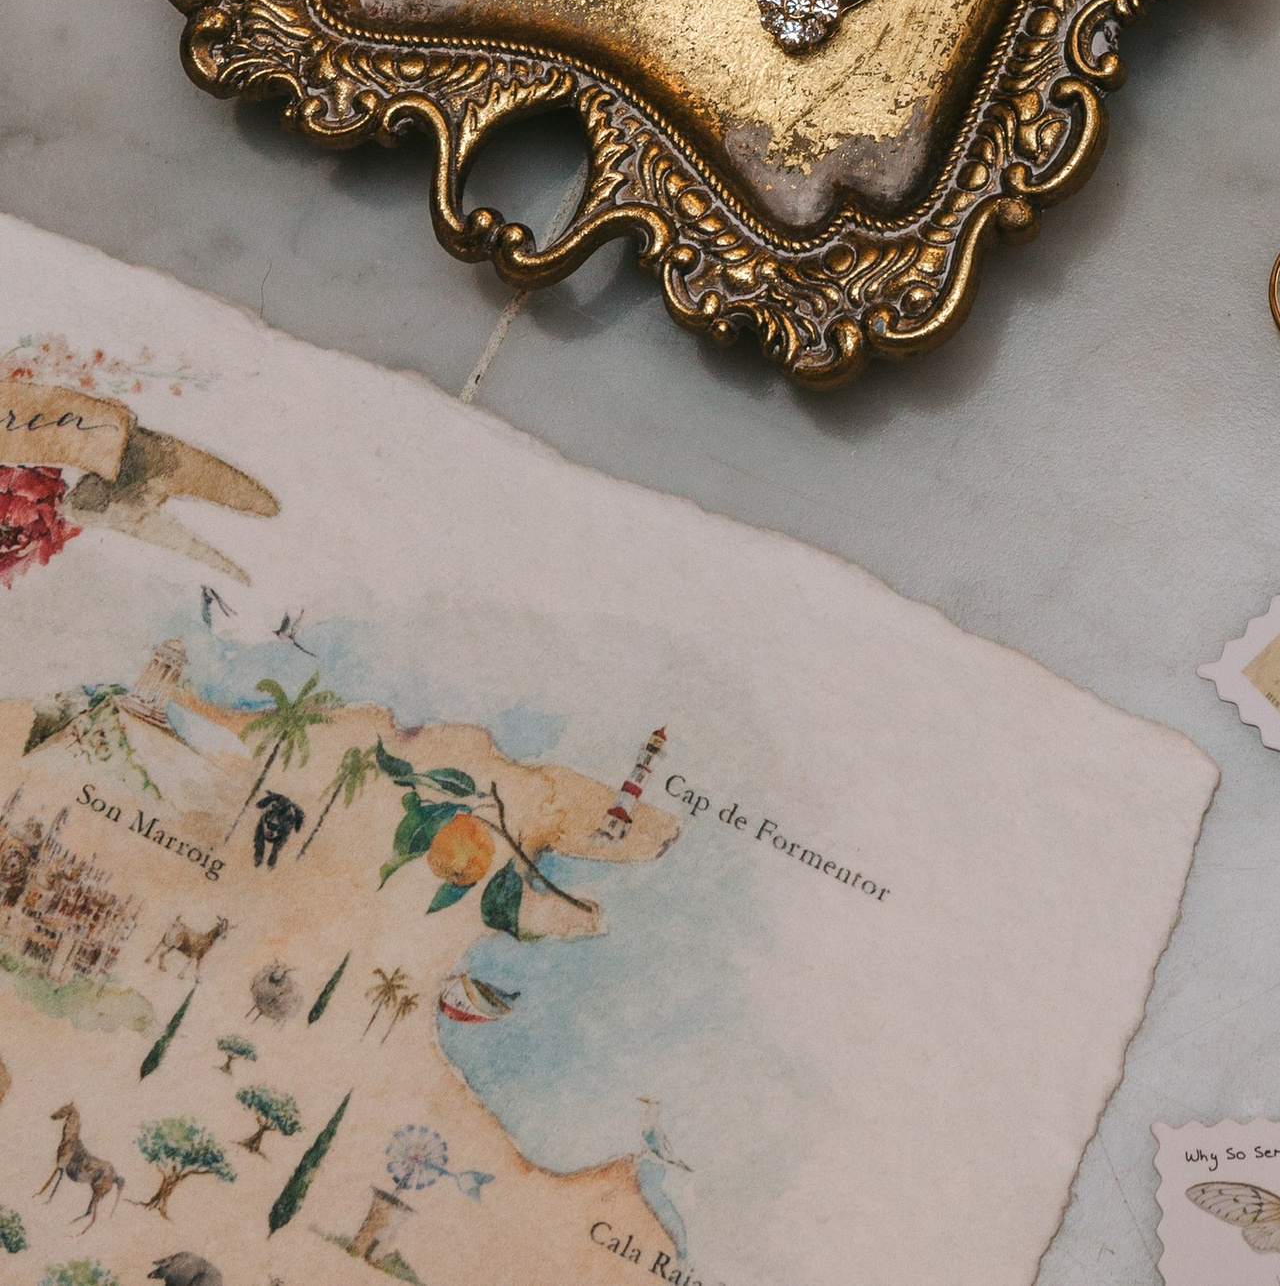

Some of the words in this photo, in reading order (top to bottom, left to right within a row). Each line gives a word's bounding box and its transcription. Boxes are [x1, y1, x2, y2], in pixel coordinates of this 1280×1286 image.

[76, 784, 123, 823] Son
[128, 809, 226, 882] Marroig
[664, 774, 710, 816] Cap
[718, 803, 748, 830] de
[754, 818, 891, 903] Formentor
[1185, 1149, 1219, 1172] Why
[1226, 1147, 1246, 1160] So
[589, 1221, 642, 1265] Cala
